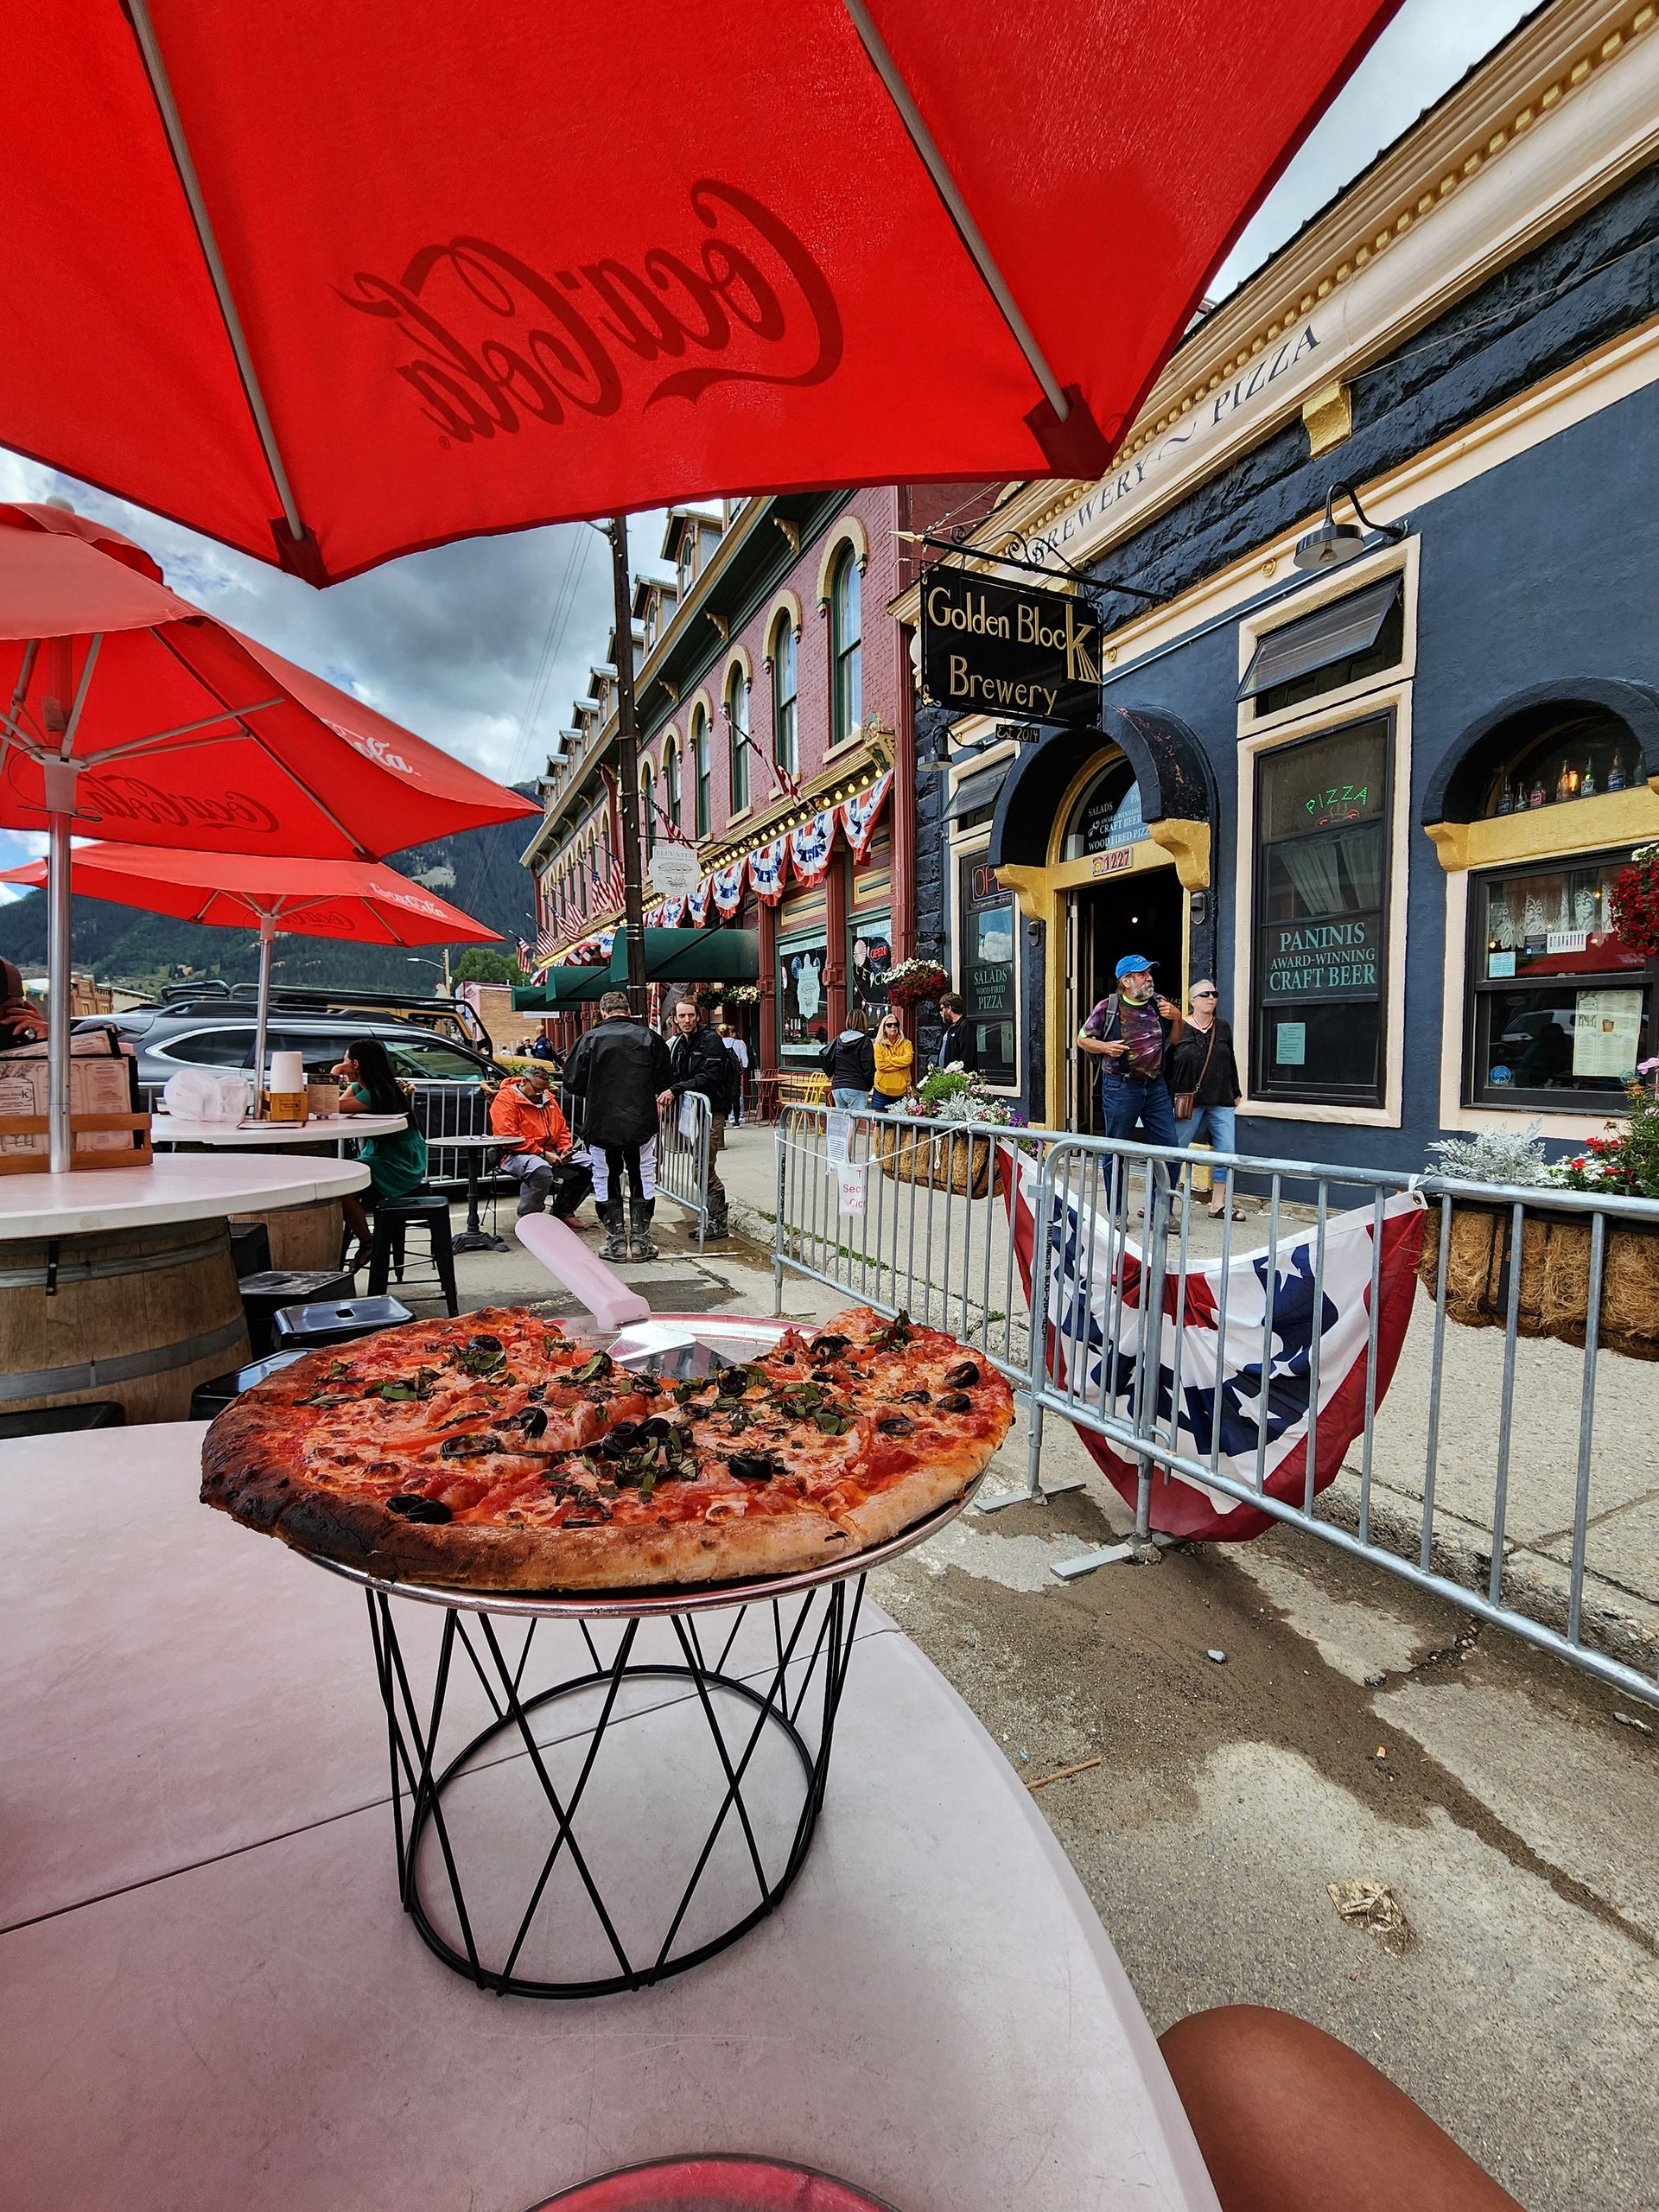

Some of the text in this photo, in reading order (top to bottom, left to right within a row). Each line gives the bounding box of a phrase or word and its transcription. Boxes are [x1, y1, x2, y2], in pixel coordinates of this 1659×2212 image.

[1211, 325, 1321, 427] PIZZA
[928, 587, 1010, 639] Golden
[950, 655, 1057, 715] Brewery
[1017, 728, 1039, 742] 2014
[1089, 802, 1114, 817] SALADS
[1305, 785, 1368, 815] PIZZA
[1099, 820, 1123, 835] CRAFT
[1089, 838, 1109, 851] WOOD
[1111, 833, 1132, 845] FIRED
[1103, 851, 1129, 871] 1227
[1280, 922, 1365, 952] PANINIS
[870, 946, 887, 960] OPEN
[1271, 948, 1376, 969] AWARD-WINNING
[974, 968, 1007, 985] SALADS
[1270, 963, 1376, 991] CRAFT BEER
[978, 995, 1002, 1009] PIZZA
